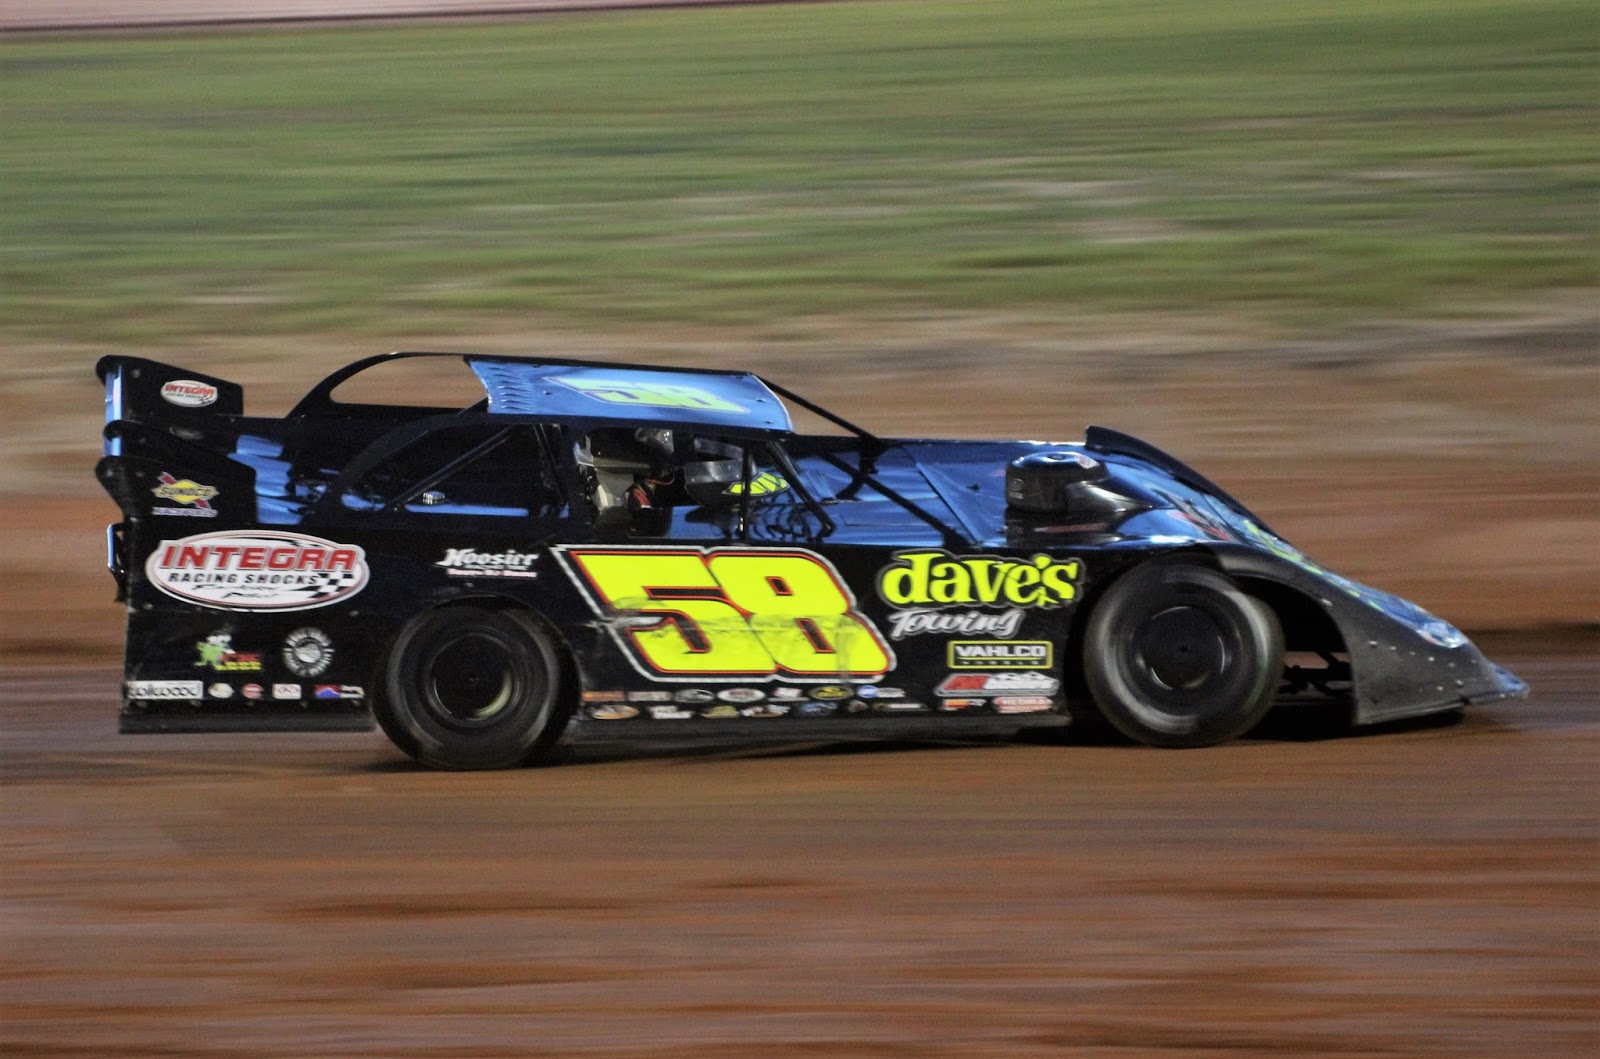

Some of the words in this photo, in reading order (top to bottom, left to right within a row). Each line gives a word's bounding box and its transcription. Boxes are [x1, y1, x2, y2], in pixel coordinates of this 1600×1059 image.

[164, 383, 216, 396] INTEGRA
[159, 545, 358, 571] INTEGRA
[168, 572, 237, 584] RACING
[243, 573, 320, 586] SHOCKS
[566, 549, 892, 677] 58
[889, 608, 1024, 639] Towing
[954, 645, 1047, 657] VAHLCO
